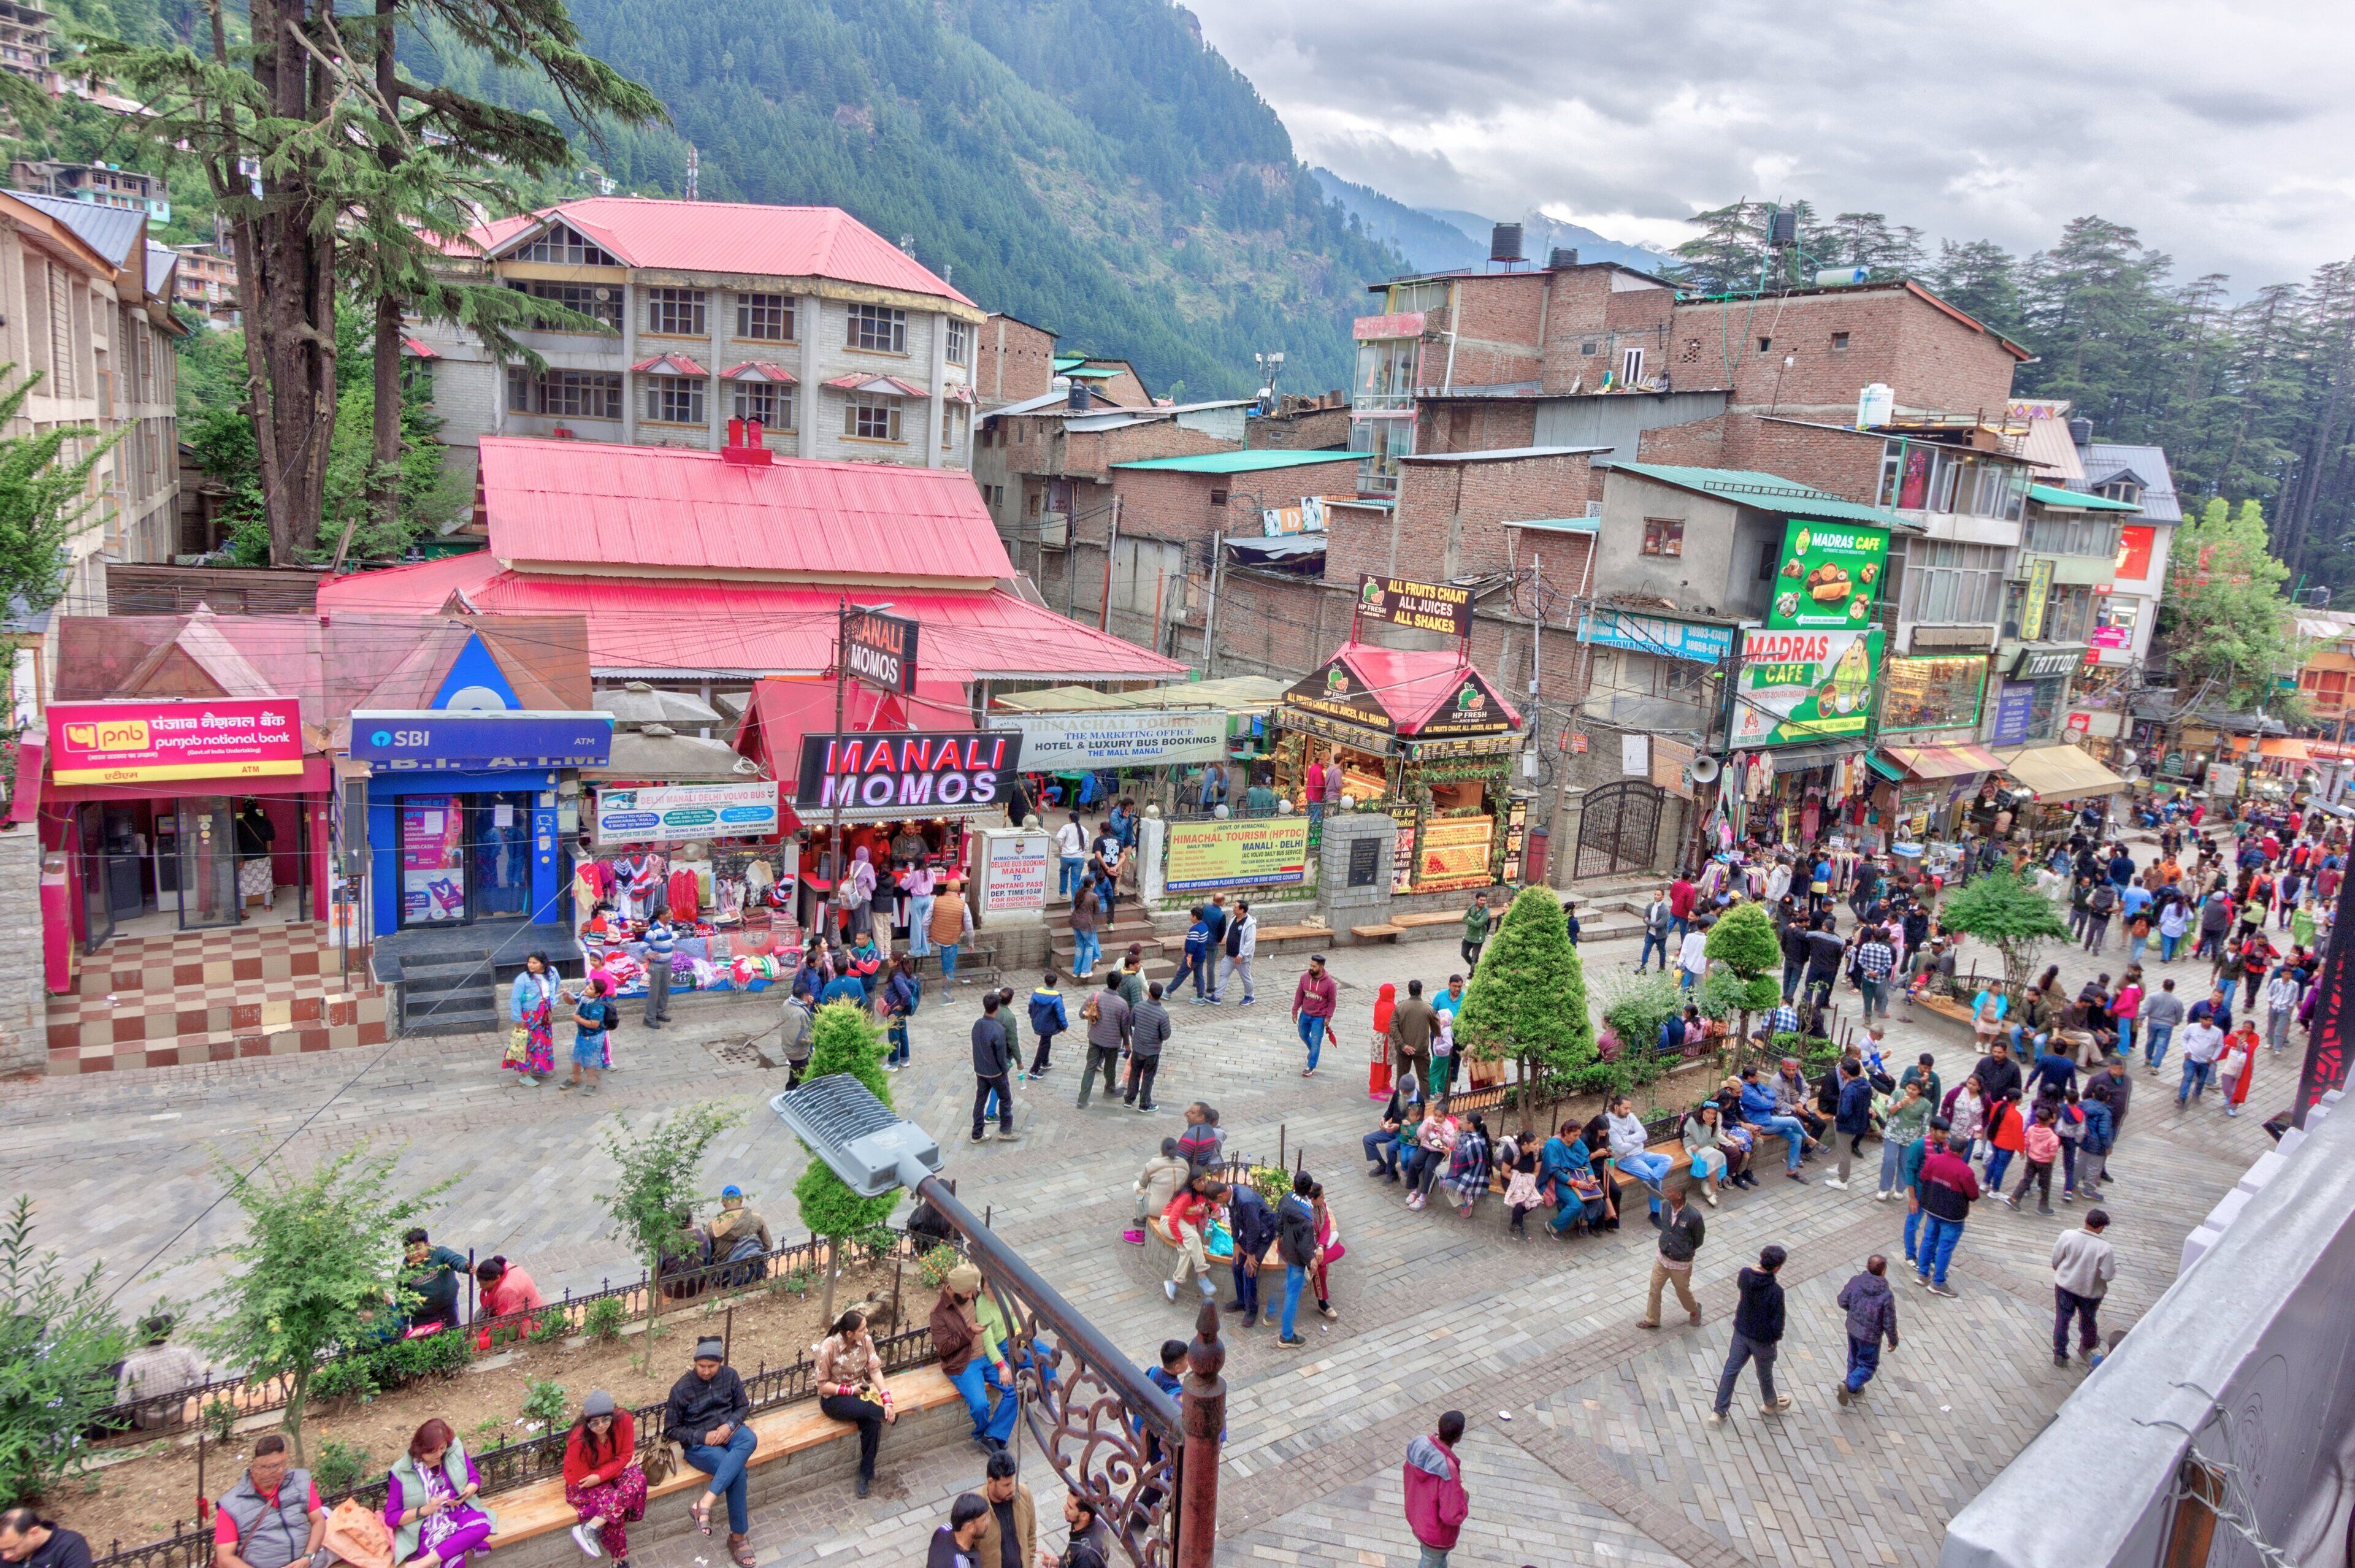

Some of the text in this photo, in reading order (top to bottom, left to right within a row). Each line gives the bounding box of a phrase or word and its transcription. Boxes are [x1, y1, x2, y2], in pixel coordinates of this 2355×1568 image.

[1812, 533, 1880, 551] MADRAS CAFE
[1388, 579, 1468, 604] ALL FRUITS CHAAT
[2025, 562, 2049, 638] TATTOO
[1368, 605, 1387, 614] FRESH
[1399, 596, 1453, 617] ALL JUICES
[1394, 611, 1455, 633] ALL SHAKES
[1615, 615, 1683, 647] GURU
[1688, 625, 1729, 642] 98903-47418
[1745, 636, 1829, 662] MADRAS
[851, 644, 897, 684] MOMOS
[2028, 654, 2079, 674] TATTOO
[1765, 664, 1804, 683] CAFE
[1742, 692, 1770, 700] AUTHENTIC
[150, 711, 285, 730] पंजाब नैशनल बैंक
[1330, 703, 1339, 714] ALL
[1339, 705, 1358, 721] JUICES,
[1358, 710, 1368, 721] ALL
[1369, 713, 1389, 727] SHAKES
[1030, 719, 1128, 732] HIMACHAL
[1090, 730, 1154, 740] MARKETING
[1156, 729, 1193, 737] OFFICE
[103, 725, 144, 746] pnb
[156, 732, 290, 749] punjab national bank
[394, 730, 429, 747] SBI
[1035, 742, 1073, 751] HOTEL
[1089, 740, 1135, 749] LUXURY
[1136, 738, 1158, 747] BUS
[1162, 736, 1217, 746] BOOKINGS
[826, 738, 1005, 774] MANALI
[1132, 747, 1163, 755] MANALI
[104, 771, 138, 779] एटीएम
[641, 796, 664, 805] DELHI
[667, 794, 696, 803] MANALI
[699, 793, 721, 802] DELHI
[724, 792, 748, 801] VOLVO
[821, 771, 997, 808] MOMOS
[1173, 828, 1305, 844] HIMACHAL TOURISM (HPTDC)
[1243, 840, 1303, 851] MANALI DELHI
[1191, 879, 1219, 888] INFORMATION
